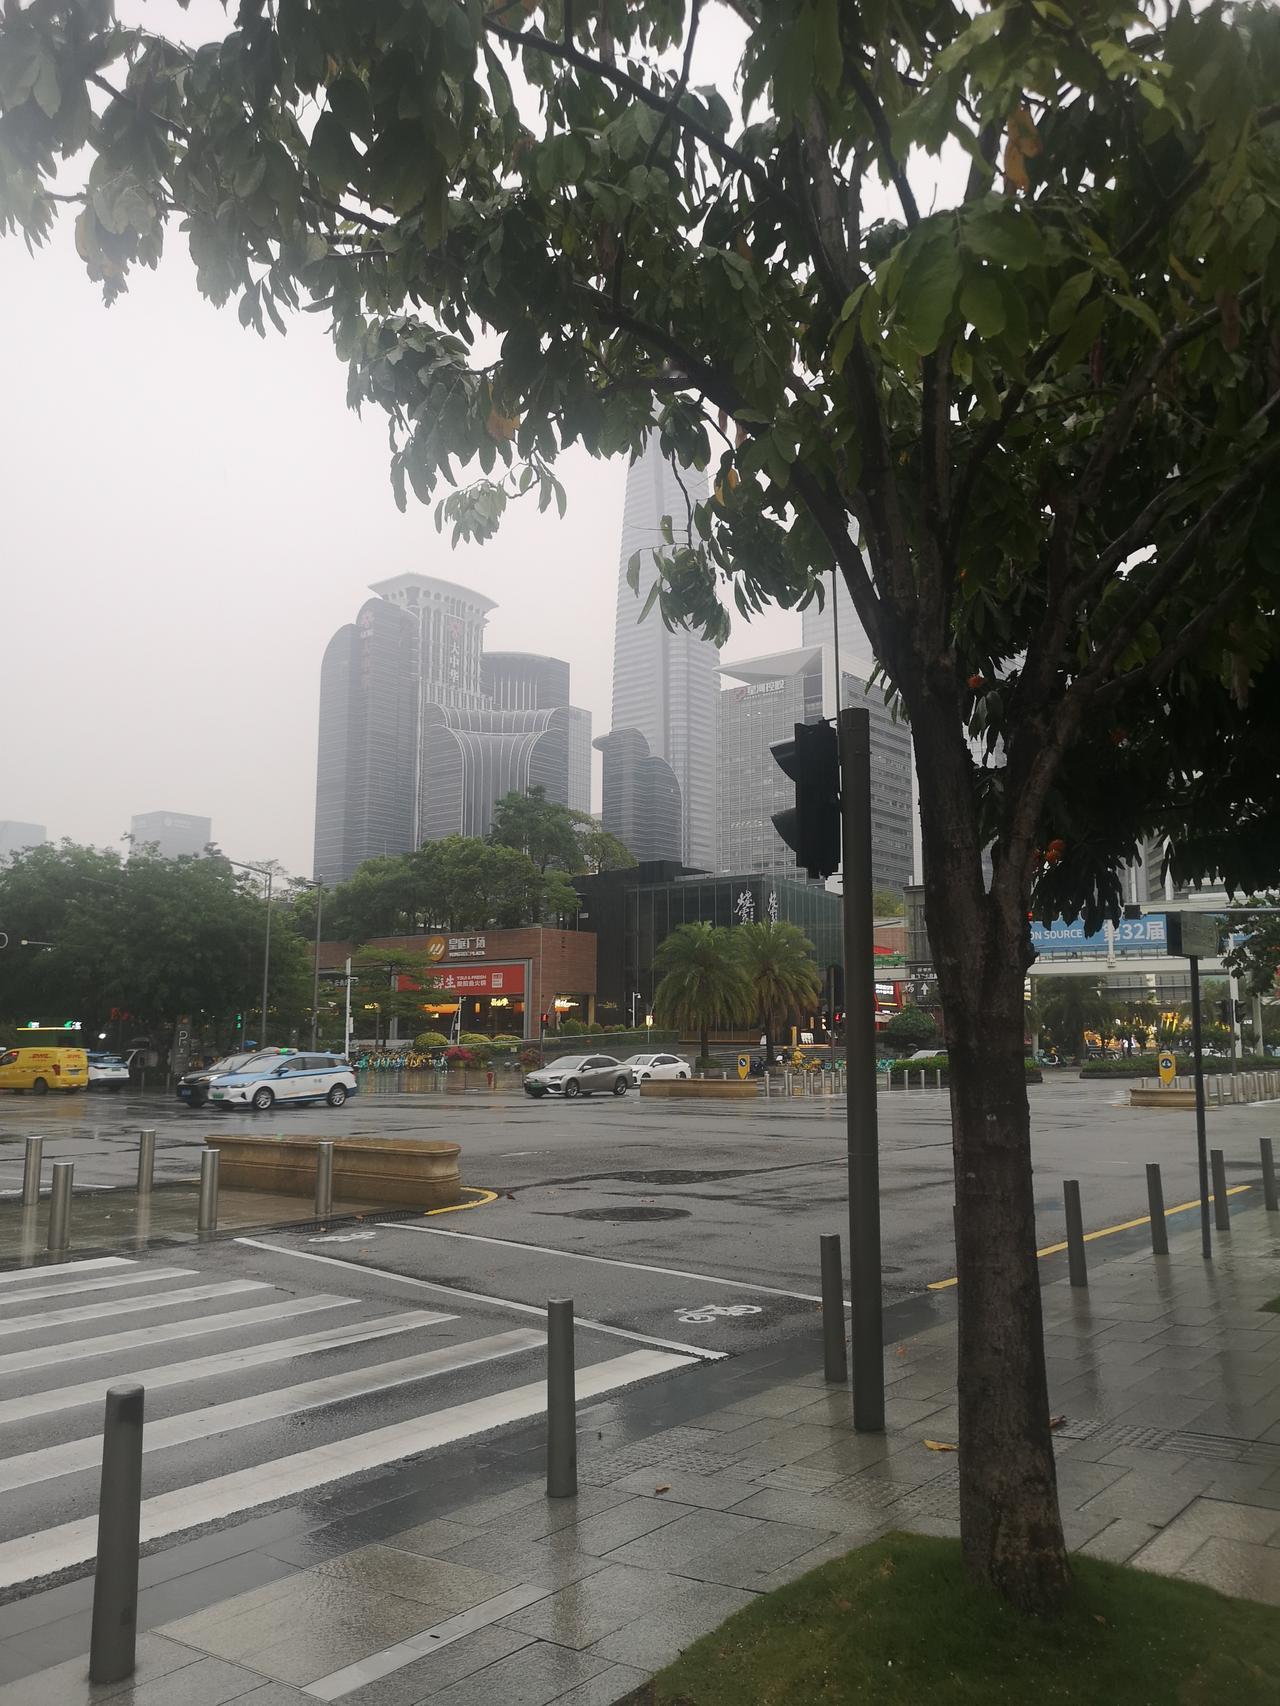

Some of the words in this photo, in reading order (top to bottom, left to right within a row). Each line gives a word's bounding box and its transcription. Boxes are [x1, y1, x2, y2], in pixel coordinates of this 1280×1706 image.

[449, 640, 460, 683] 大中华
[1043, 929, 1083, 940] SOURCE
[448, 937, 486, 950] 皇庭广场
